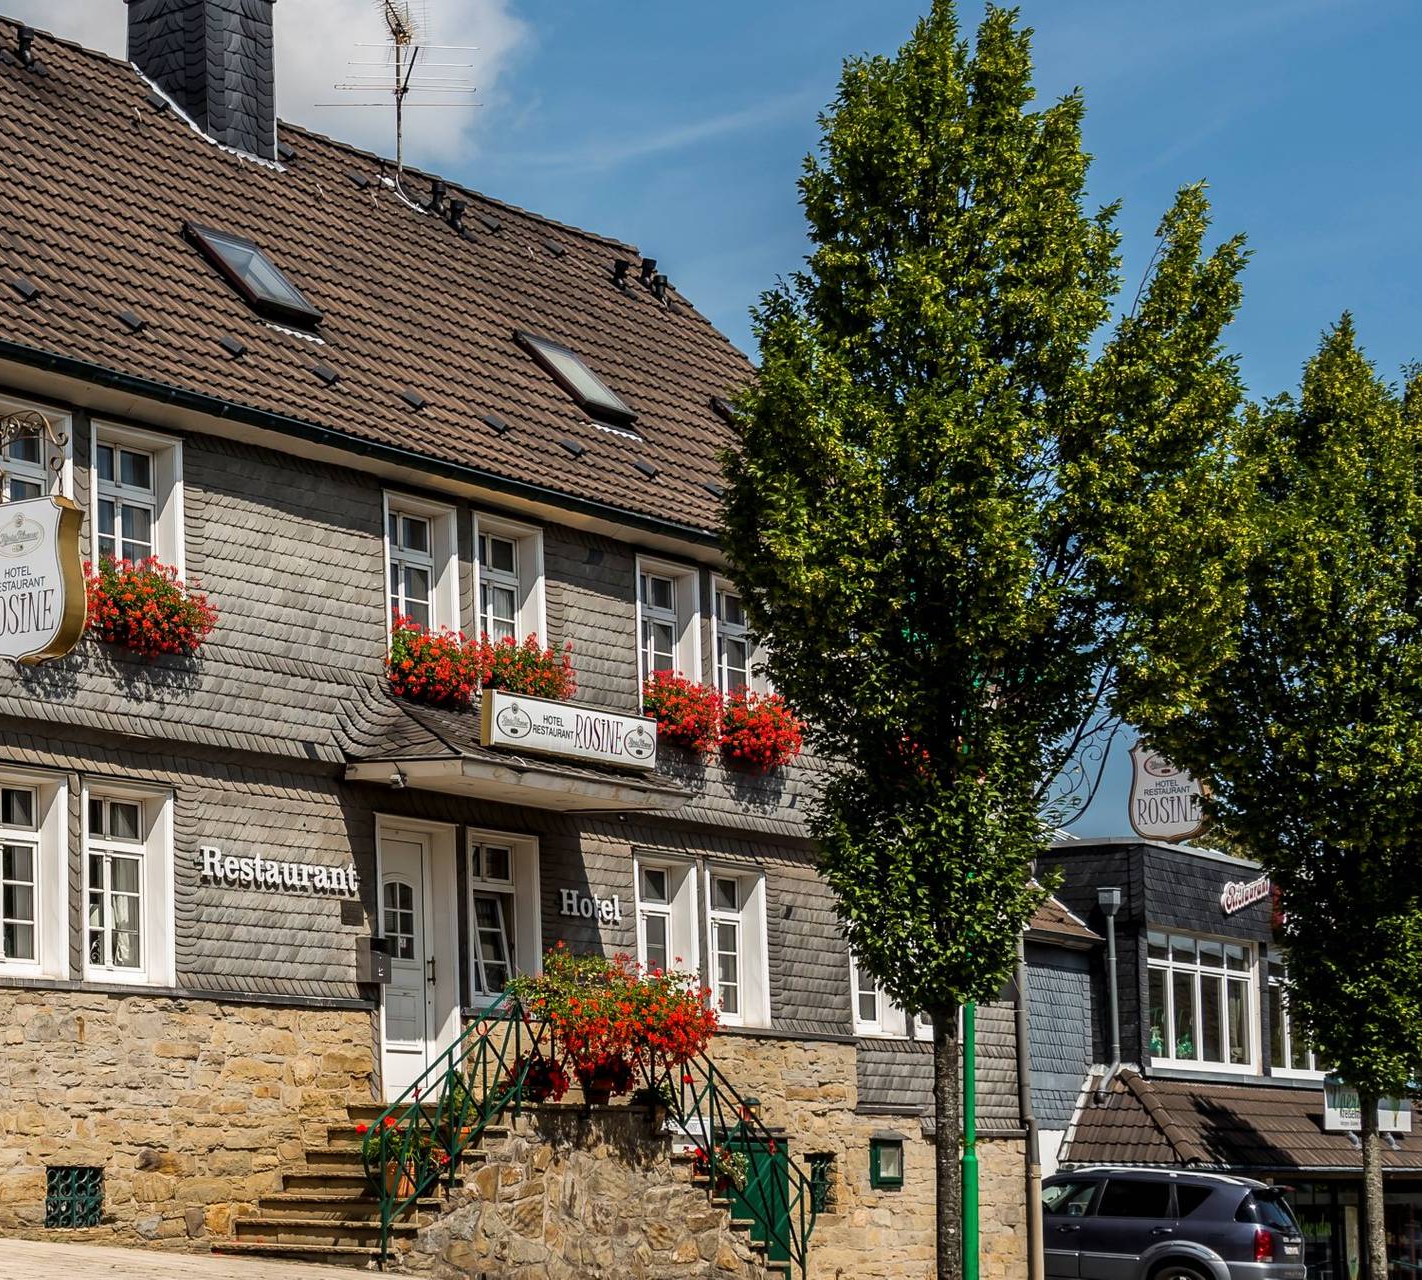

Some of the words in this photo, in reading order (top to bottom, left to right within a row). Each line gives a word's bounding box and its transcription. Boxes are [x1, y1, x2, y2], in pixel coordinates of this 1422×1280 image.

[4, 565, 31, 578] HOTEL
[542, 714, 565, 727] HOTEL
[532, 723, 574, 740] RESTAURANT
[1155, 779, 1179, 788] HOTEL
[1143, 785, 1191, 796] RESTAURANT
[199, 845, 359, 891] Restaurant
[559, 888, 623, 921] Hotel
